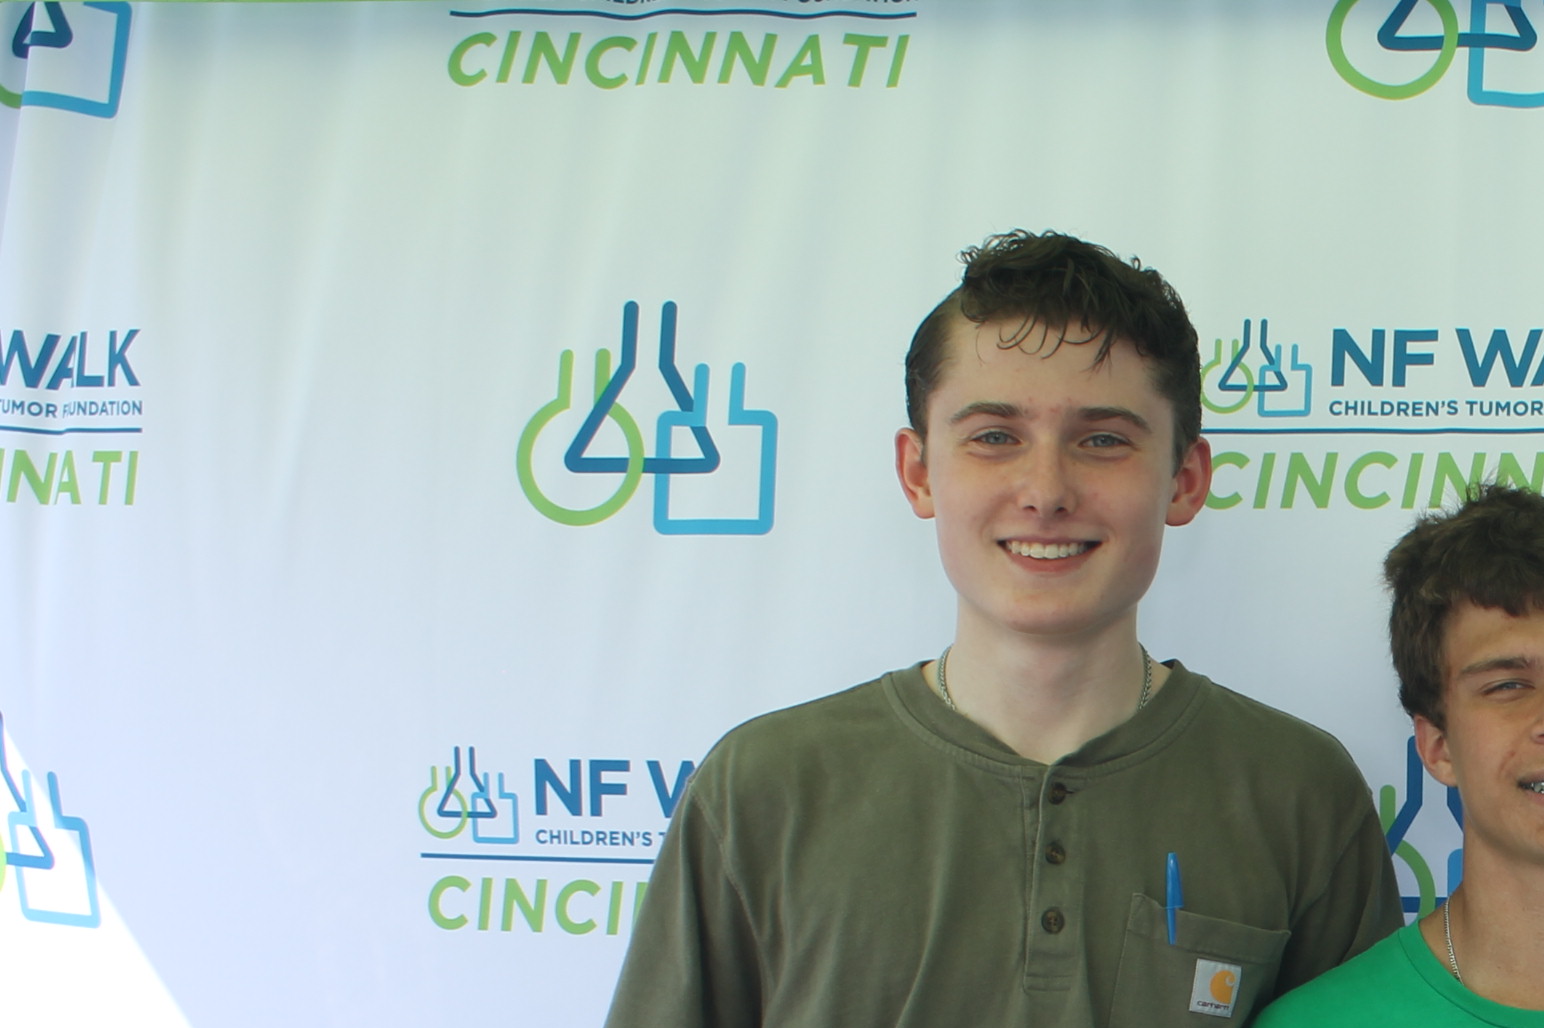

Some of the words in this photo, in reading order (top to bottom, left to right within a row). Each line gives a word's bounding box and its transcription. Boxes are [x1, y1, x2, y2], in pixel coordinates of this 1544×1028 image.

[447, 30, 911, 90] CINCINNATI
[0, 328, 142, 391] WALK
[1330, 327, 1439, 388] NF
[1328, 400, 1459, 417] CHILDREN'S
[1466, 400, 1544, 417] TUMOR
[534, 758, 631, 817] NF
[535, 829, 653, 847] CHILDREN'S
